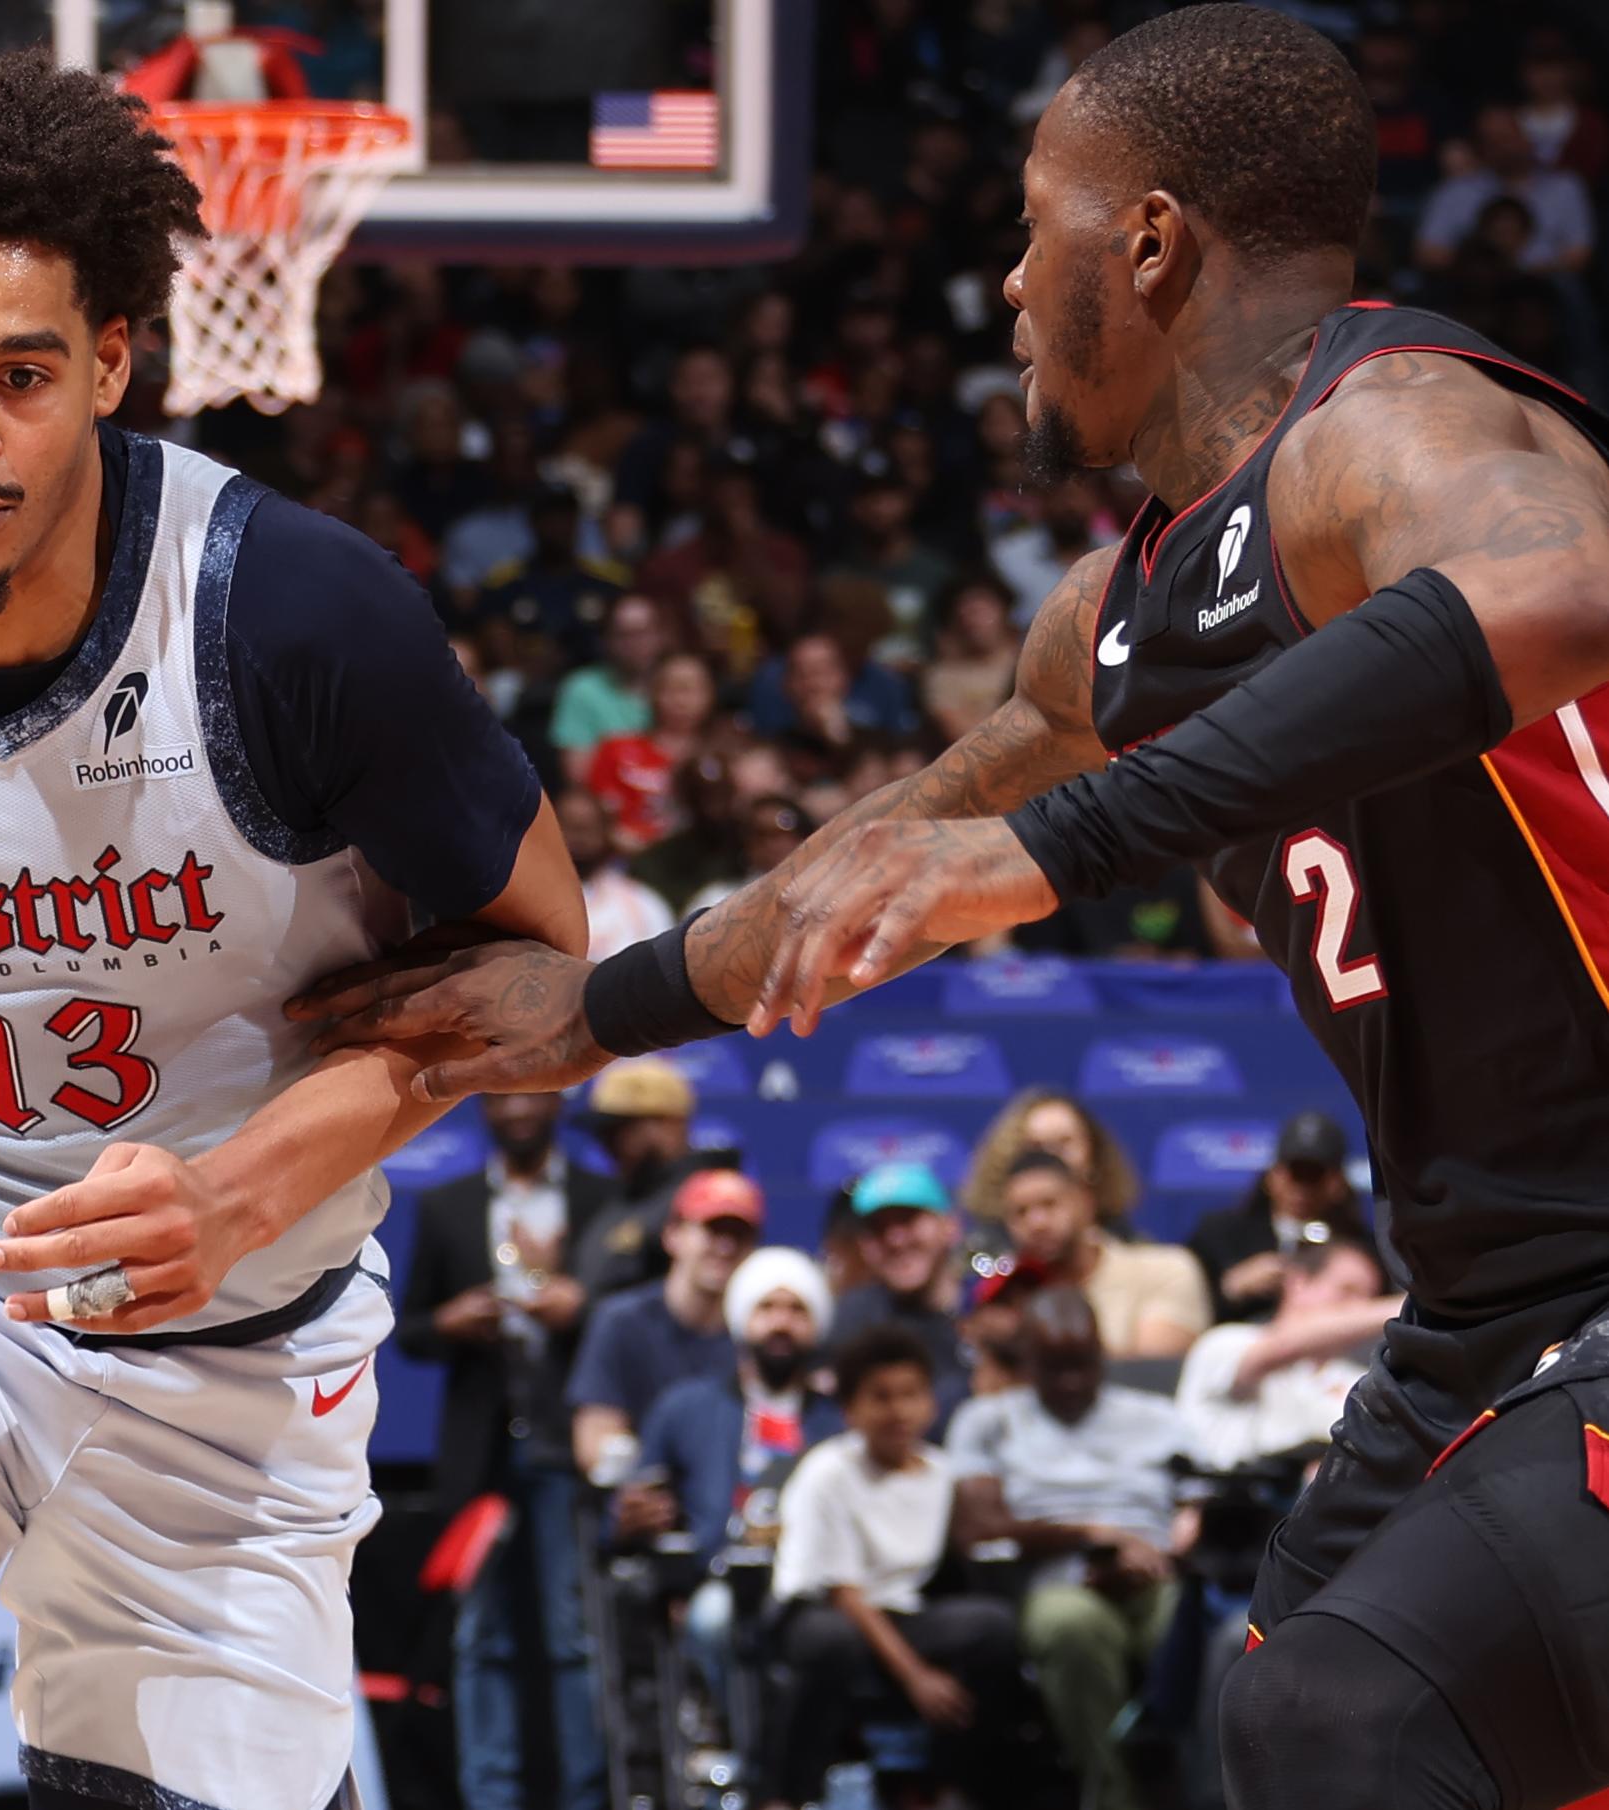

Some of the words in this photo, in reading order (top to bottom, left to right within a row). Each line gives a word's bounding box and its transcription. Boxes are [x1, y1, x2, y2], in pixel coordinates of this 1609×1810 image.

[1198, 579, 1260, 632] Robinhood
[76, 749, 194, 785] Robinhood
[1280, 827, 1390, 1014] 2
